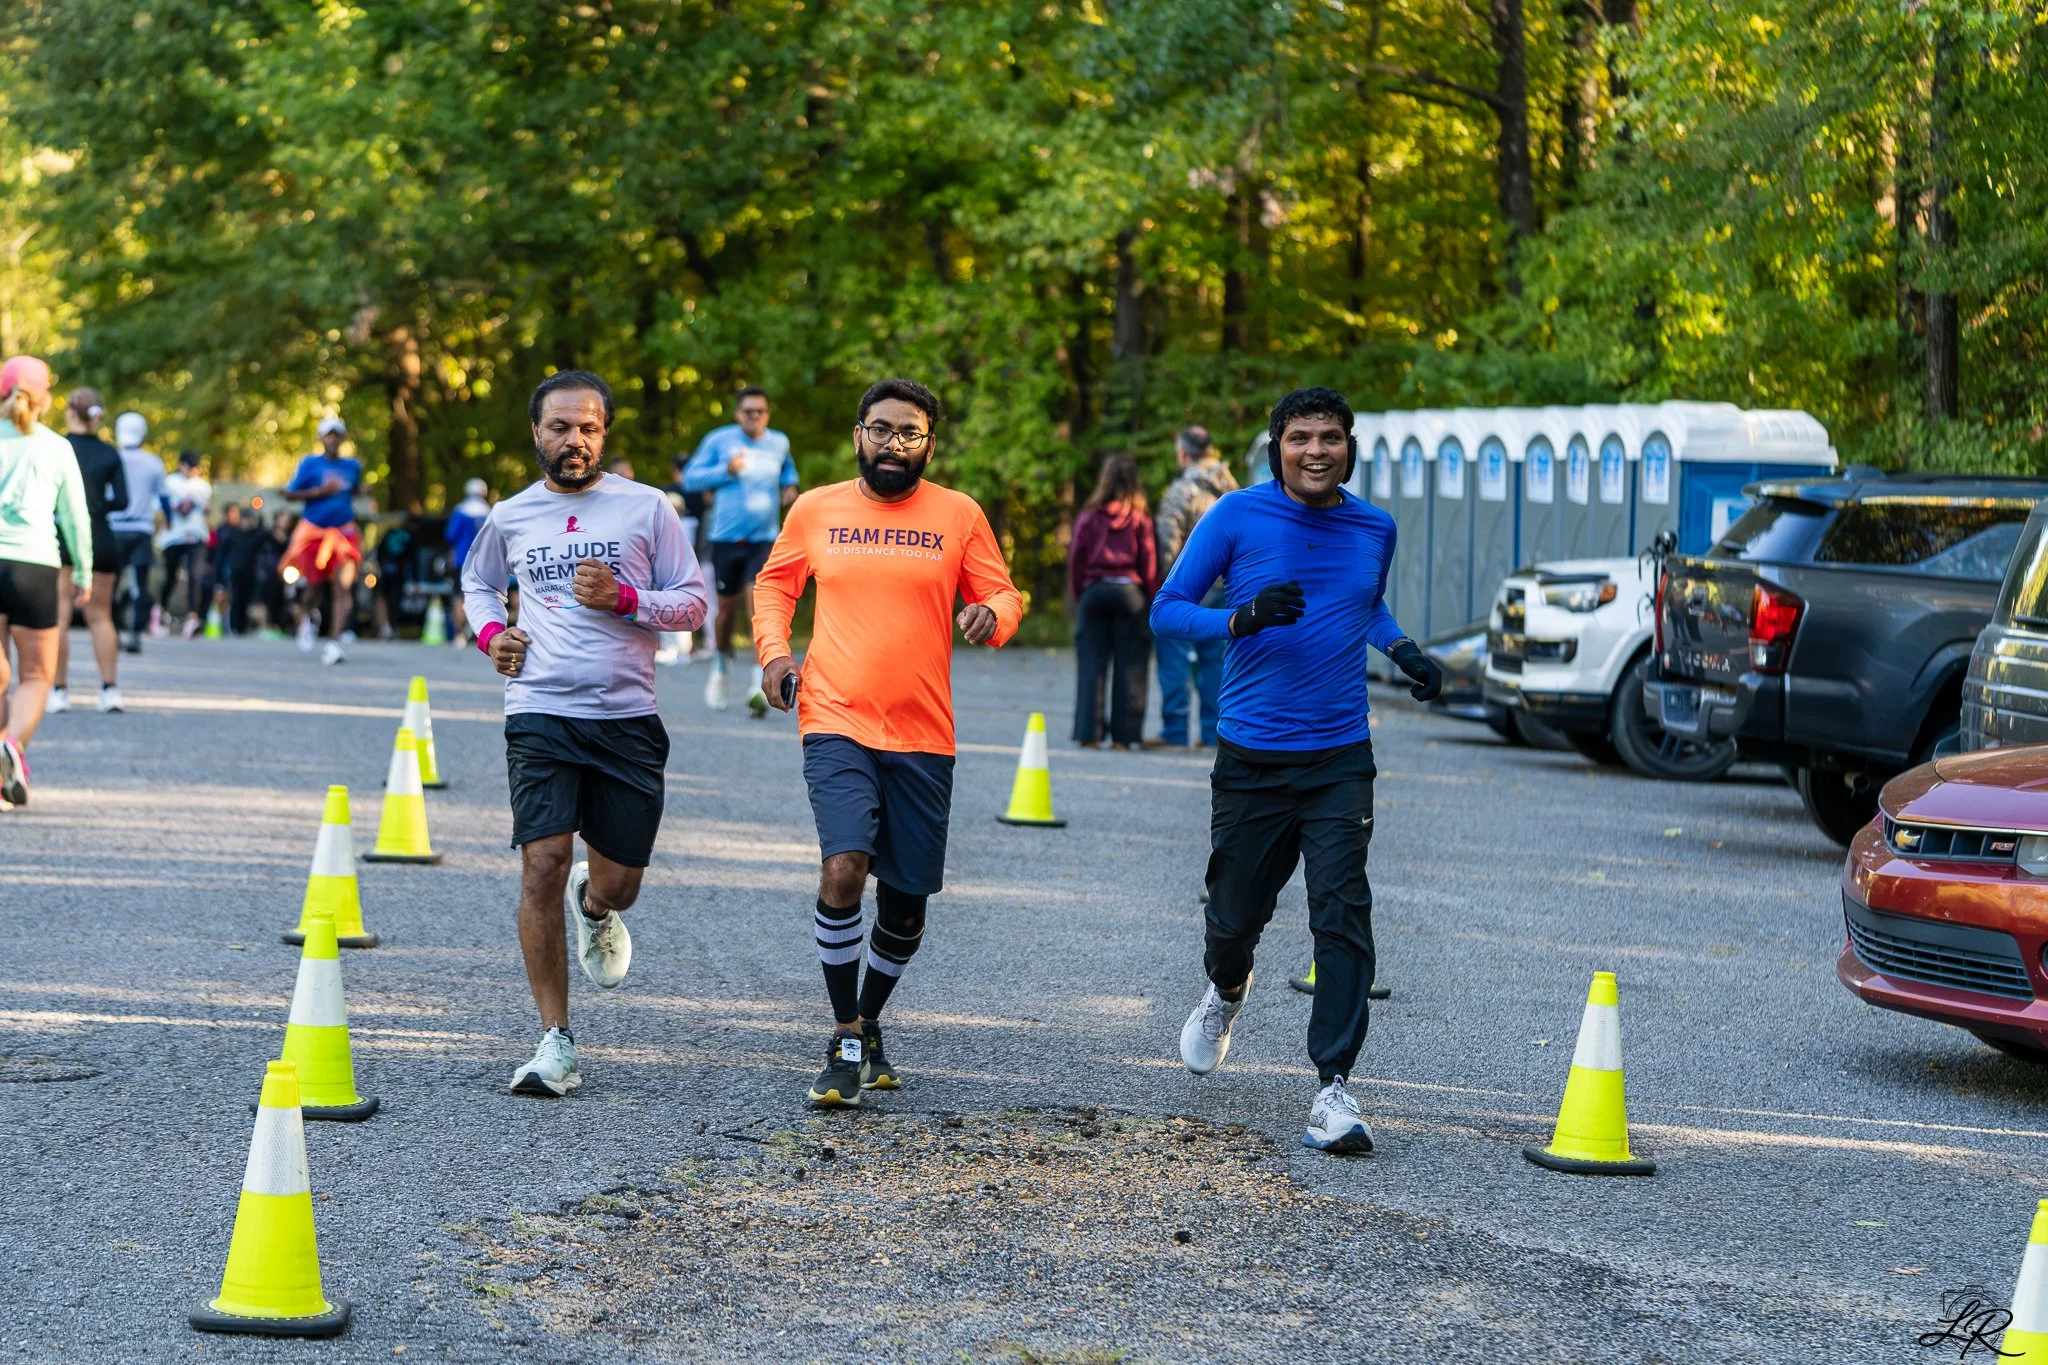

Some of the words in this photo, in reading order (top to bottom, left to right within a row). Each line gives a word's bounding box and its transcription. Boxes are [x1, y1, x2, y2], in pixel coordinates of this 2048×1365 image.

[828, 527, 880, 545] TEAM
[884, 528, 945, 551] FEDEX
[526, 546, 555, 565] ST.
[559, 541, 621, 560] JUDE
[826, 546, 841, 555] NO
[843, 546, 897, 556] DISTANCE
[900, 548, 922, 558] TOO
[925, 551, 944, 562] FAR
[528, 561, 621, 583] MEMS
[535, 582, 575, 595] MARATHO
